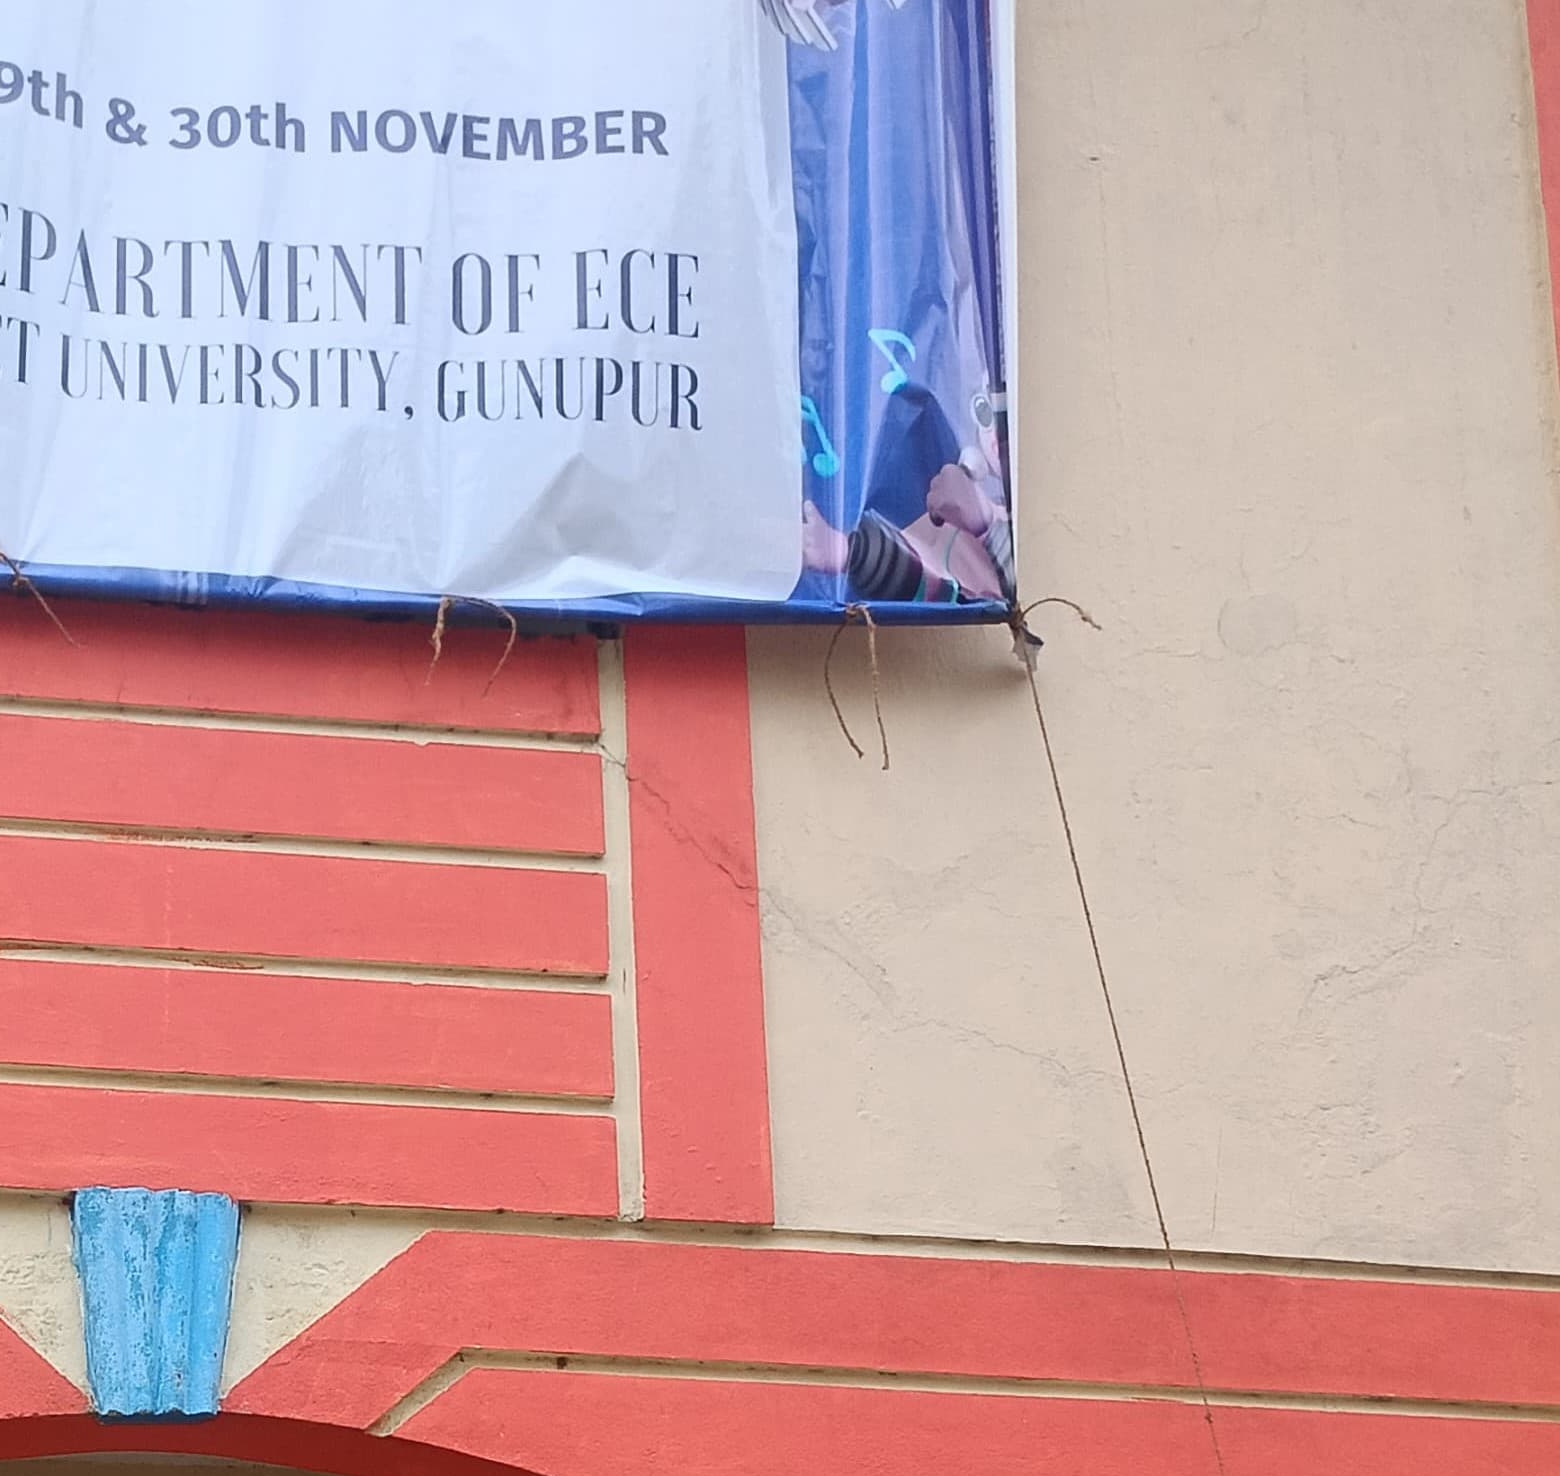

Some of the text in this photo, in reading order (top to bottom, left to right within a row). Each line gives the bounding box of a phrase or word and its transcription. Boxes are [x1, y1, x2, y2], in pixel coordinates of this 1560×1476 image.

[105, 97, 148, 147] &
[168, 101, 306, 154] 30th
[330, 108, 669, 161] NOVEMBER
[451, 252, 541, 335] OF
[572, 248, 700, 338] ECE
[59, 330, 414, 420] UNIVERSITY,
[436, 355, 703, 431] GUNUPUR
